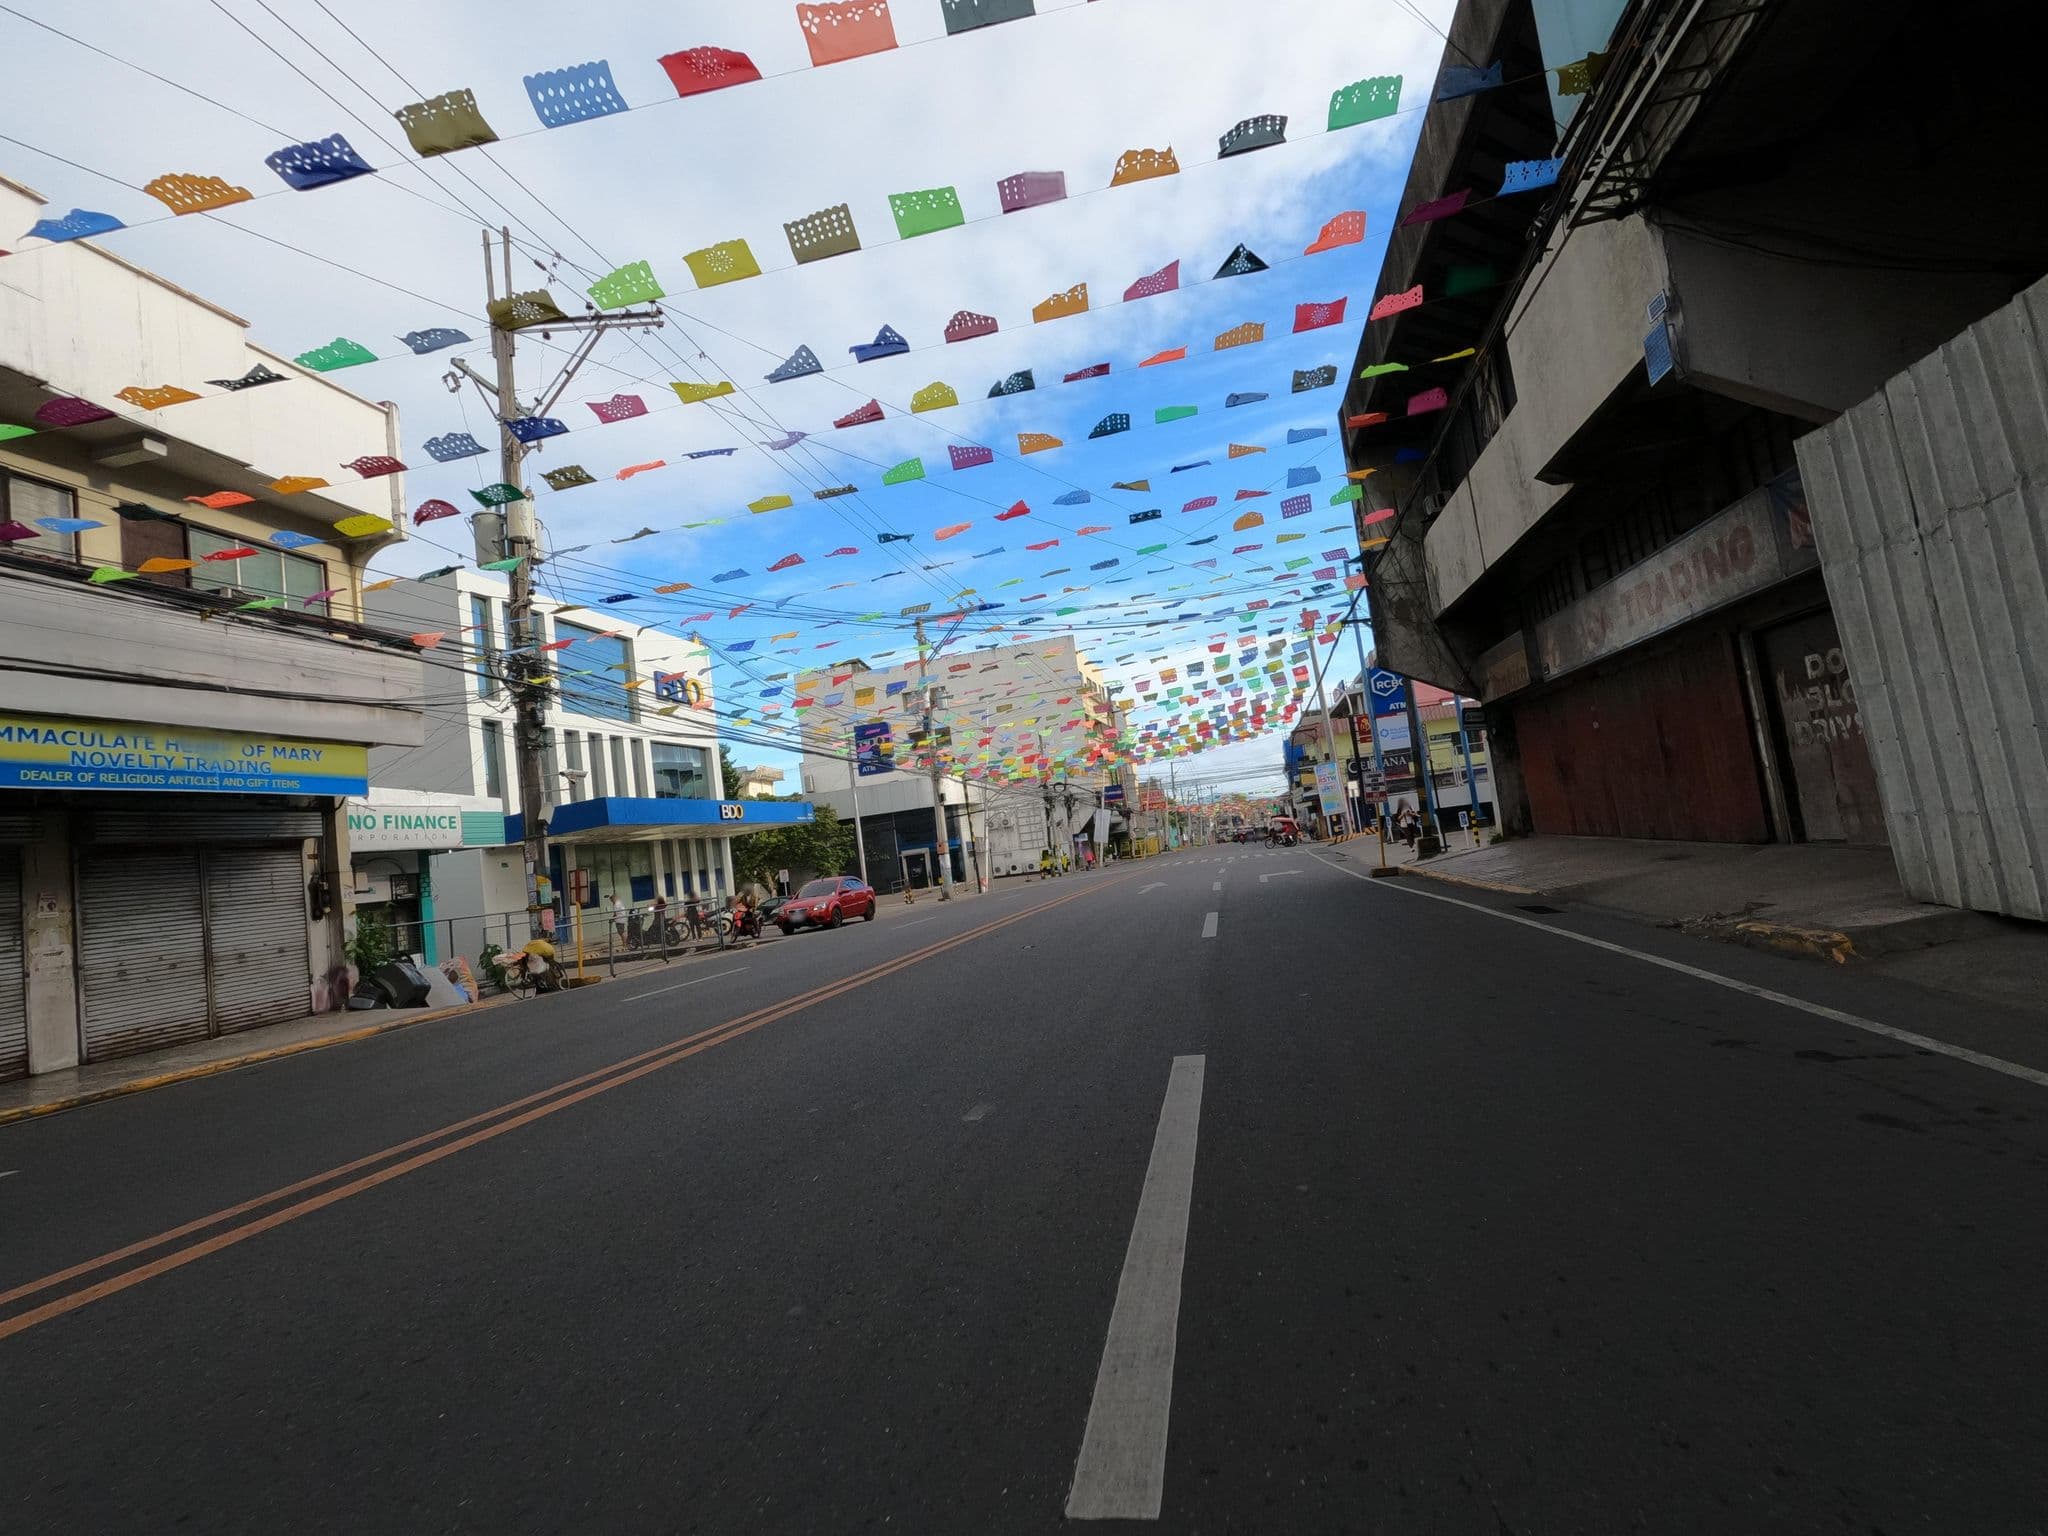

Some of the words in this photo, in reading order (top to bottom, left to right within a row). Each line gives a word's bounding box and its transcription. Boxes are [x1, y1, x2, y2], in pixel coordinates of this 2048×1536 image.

[1619, 524, 1755, 626] TRADING
[653, 671, 705, 705] BDO
[0, 726, 156, 750] MMACULATE
[71, 750, 175, 770] NOVELTY
[182, 756, 272, 775] TRADING
[241, 744, 266, 758] OF
[272, 746, 323, 762] MARY
[20, 769, 73, 782] DEALER
[77, 772, 96, 783] OF
[100, 773, 165, 785] RELIGIOUS
[168, 775, 219, 786] ARTICLES
[222, 777, 245, 787] AND
[247, 778, 269, 788] GIFT
[272, 779, 300, 789] ITEMS
[383, 815, 457, 829] FINANCE
[720, 804, 744, 820] BDO
[357, 833, 448, 841] RPORATION
